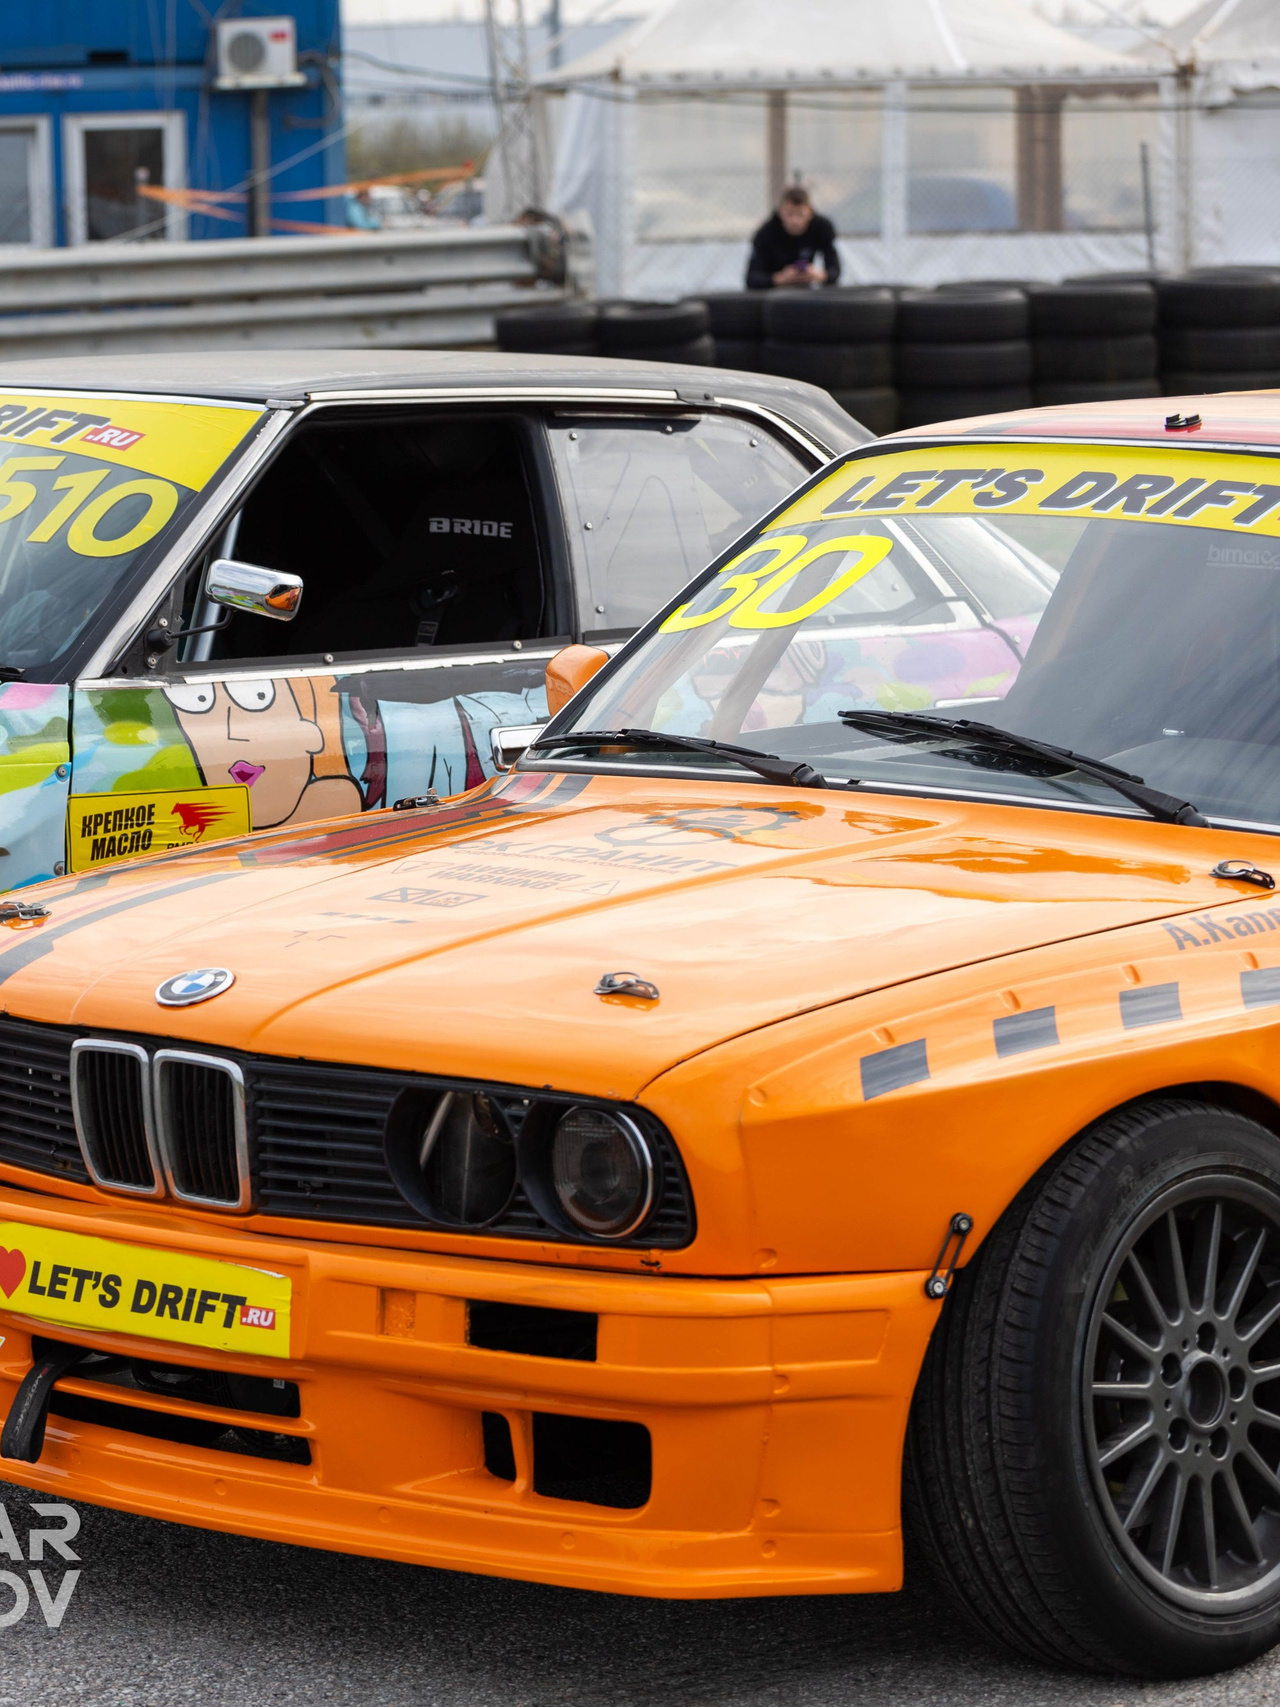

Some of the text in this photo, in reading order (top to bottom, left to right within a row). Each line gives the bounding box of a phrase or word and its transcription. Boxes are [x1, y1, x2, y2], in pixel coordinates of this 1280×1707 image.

[821, 468, 1046, 516] LET'S
[428, 517, 514, 539] BRIDE
[658, 534, 894, 634] 30
[81, 803, 156, 838] КРЕПКОЕ
[90, 828, 153, 861] МАСЛО
[520, 844, 739, 873] ГРАНИТ
[427, 870, 559, 890] WARNING
[28, 1260, 122, 1309] LET'S
